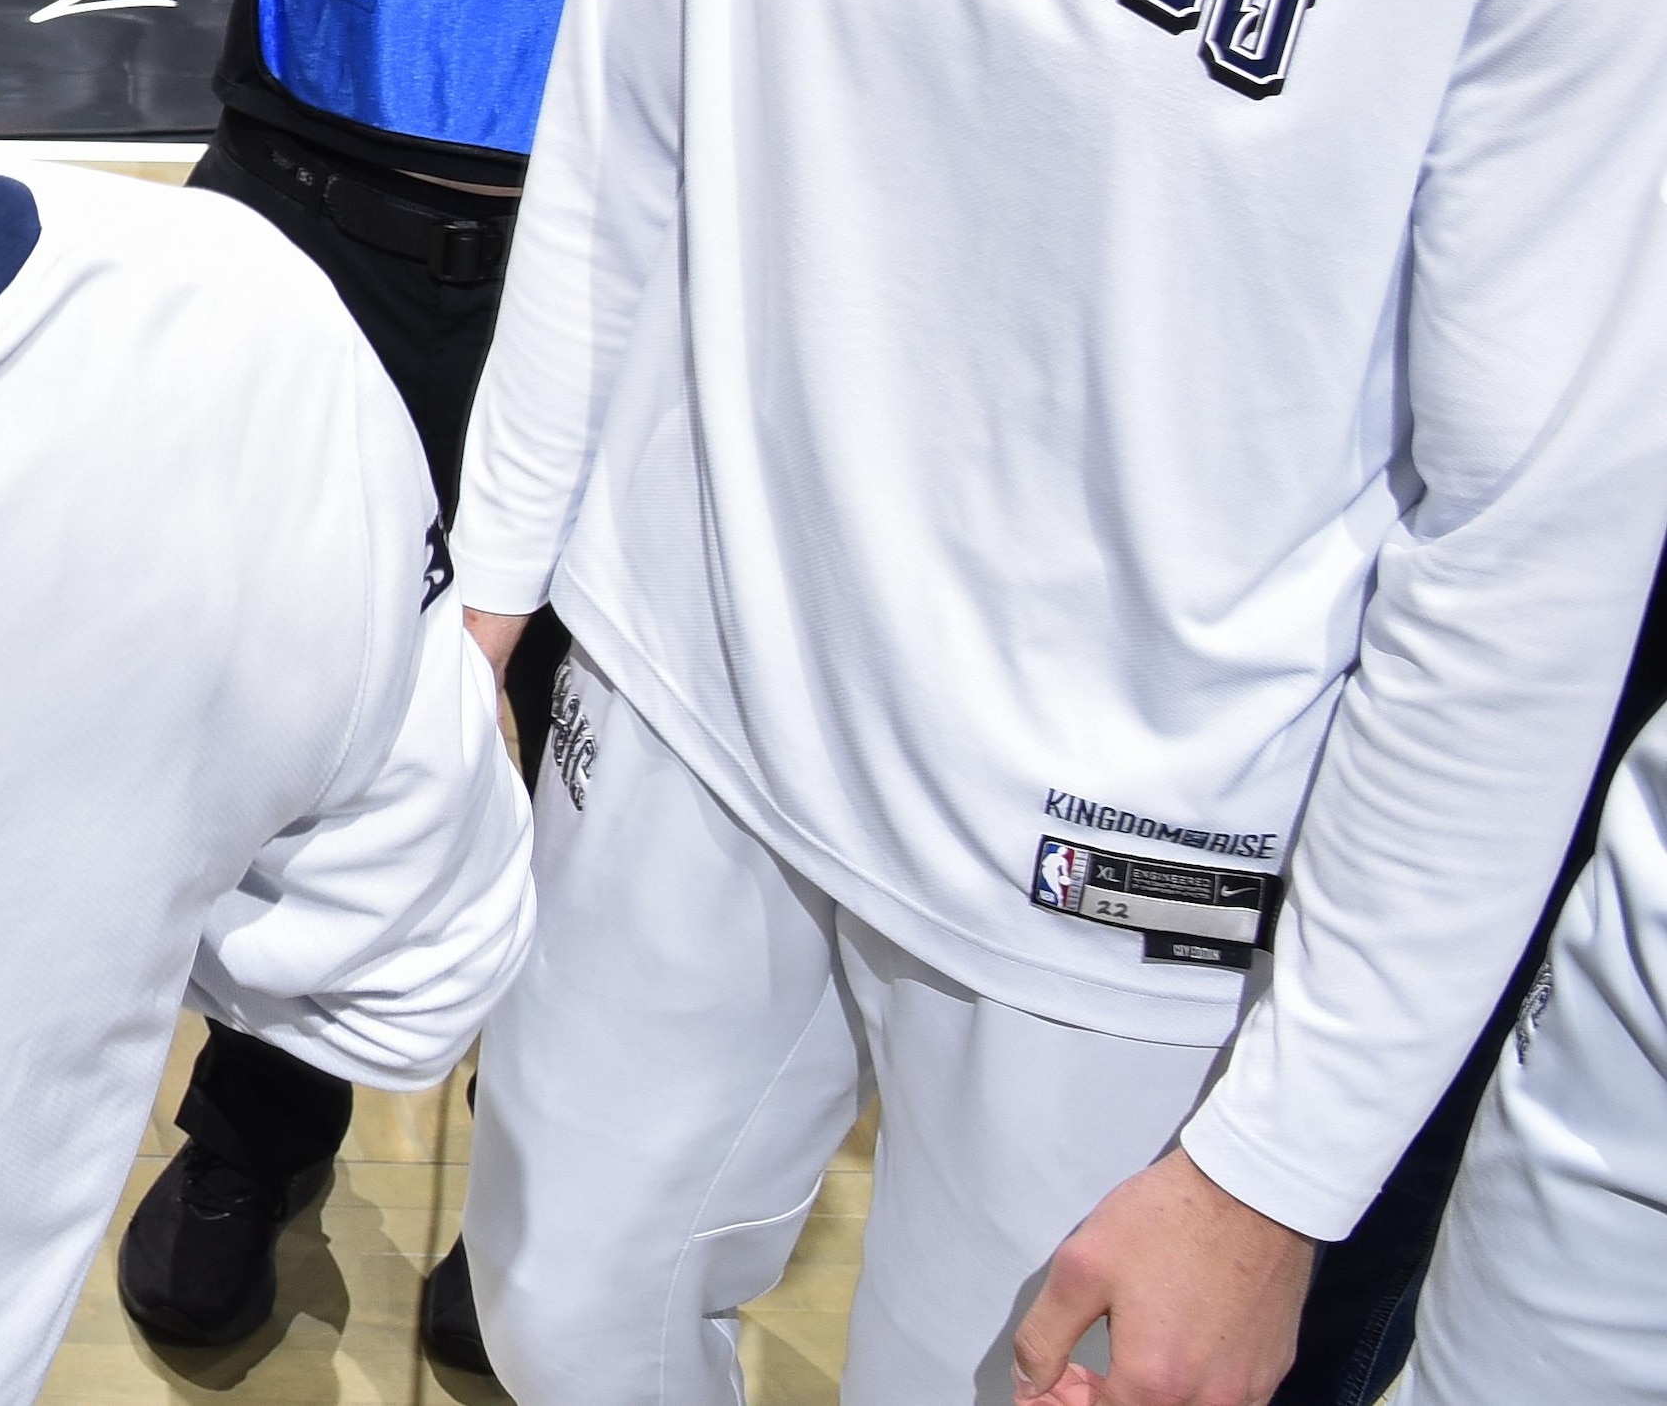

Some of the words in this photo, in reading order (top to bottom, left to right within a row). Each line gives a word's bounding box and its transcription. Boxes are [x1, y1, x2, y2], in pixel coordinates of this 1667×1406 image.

[1044, 787, 1186, 843] KINGDOM
[1208, 832, 1278, 859] RISE
[1095, 865, 1122, 884] XL
[1132, 868, 1213, 886] ENGINEERED
[1096, 899, 1130, 919] 22
